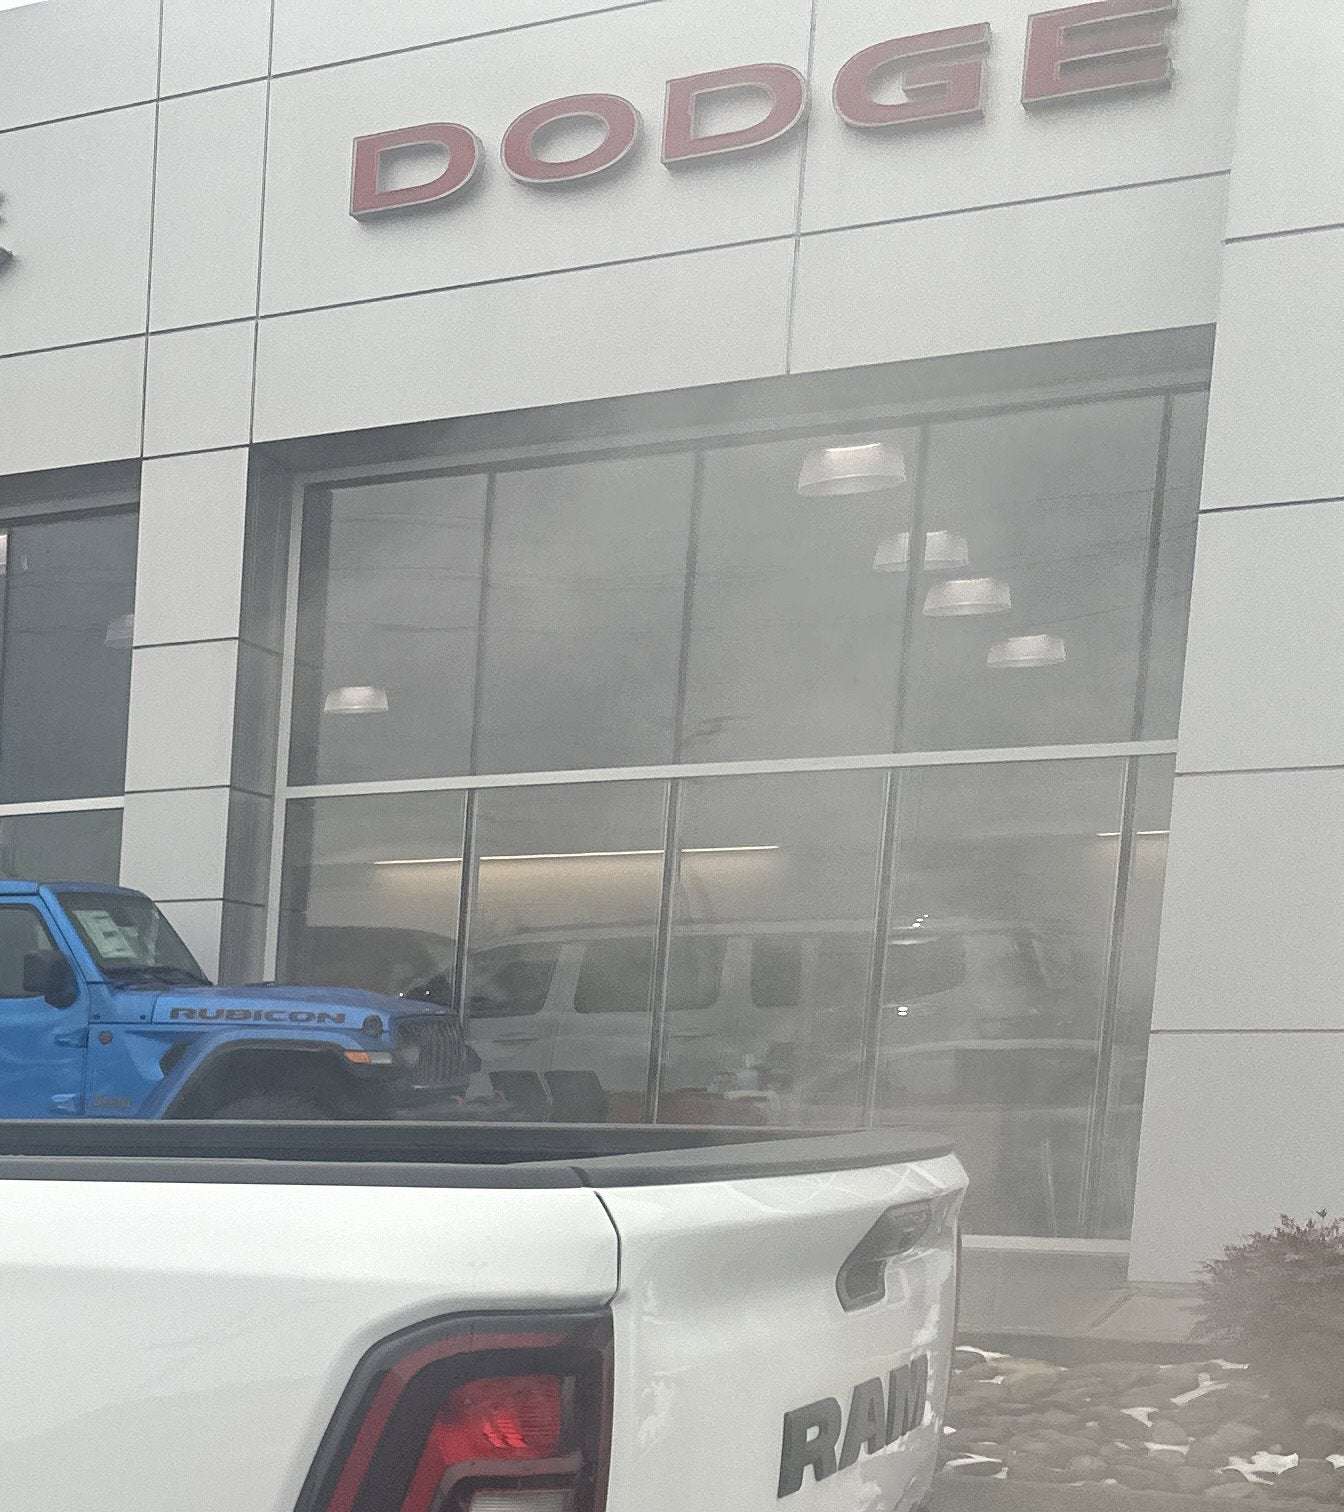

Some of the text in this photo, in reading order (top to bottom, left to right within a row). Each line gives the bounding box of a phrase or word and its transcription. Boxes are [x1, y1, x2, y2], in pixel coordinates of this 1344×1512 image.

[349, 0, 1178, 222] DODGE
[169, 1006, 346, 1025] RUBICON
[777, 1353, 929, 1499] RAM
